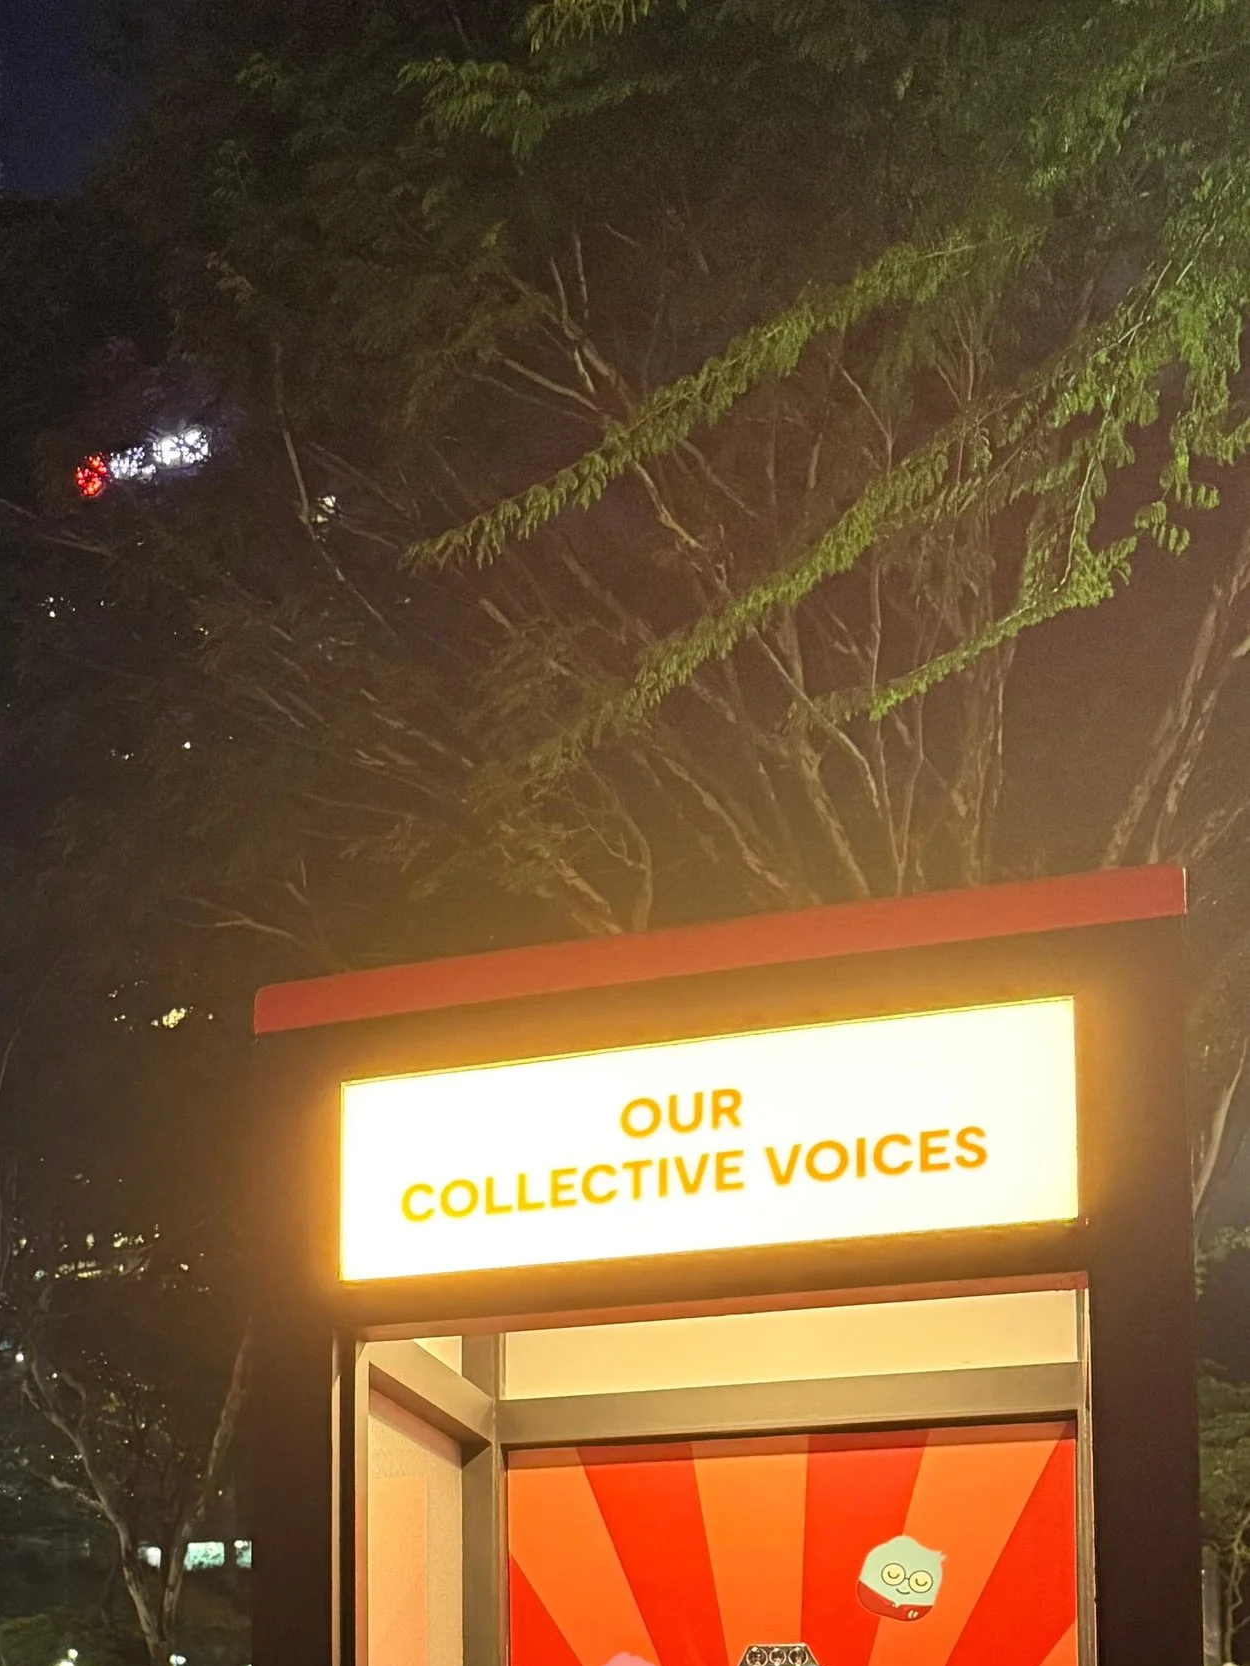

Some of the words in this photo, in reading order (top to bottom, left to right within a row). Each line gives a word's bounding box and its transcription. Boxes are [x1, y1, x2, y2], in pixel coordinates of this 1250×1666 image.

[619, 1086, 744, 1140] OUR
[400, 1148, 745, 1223] COLLECTIVE
[765, 1125, 988, 1188] VOICES
